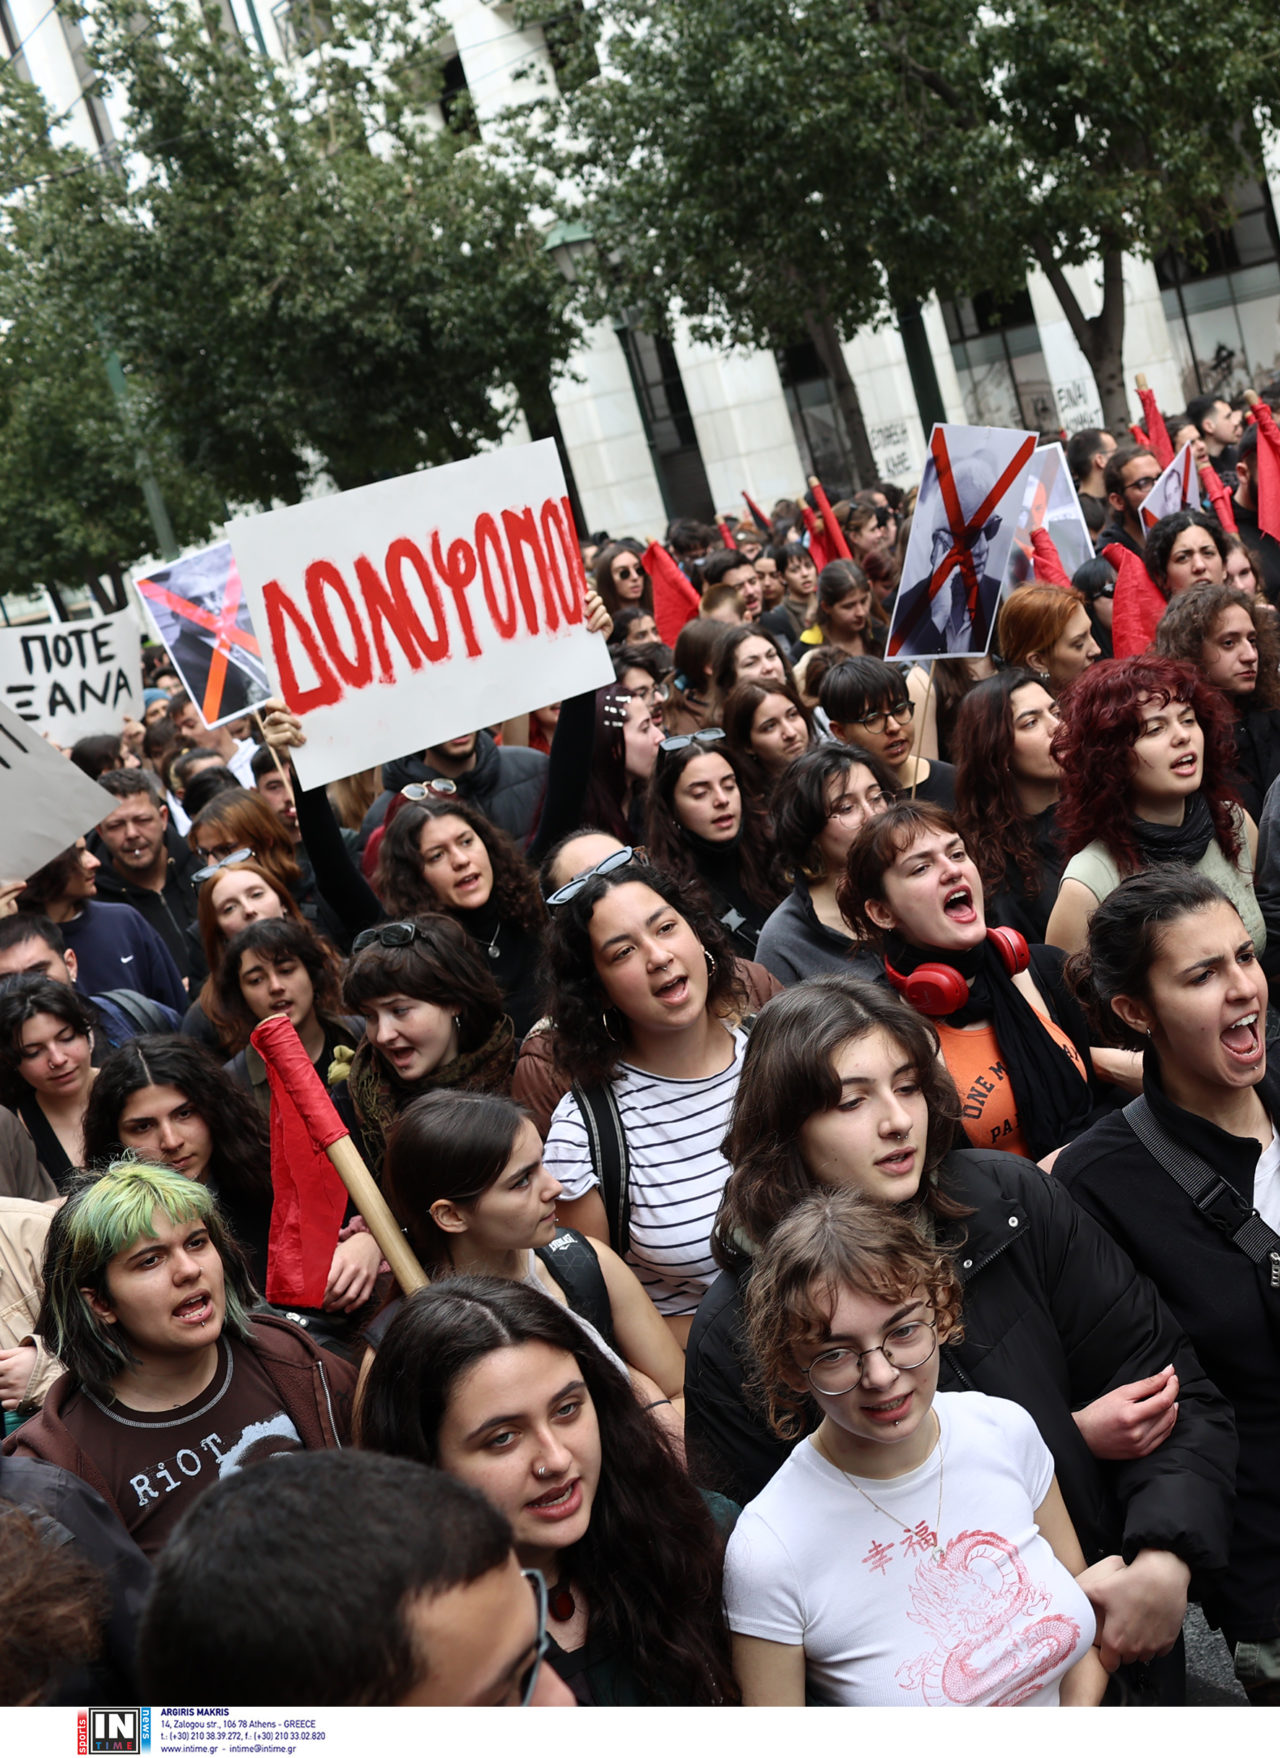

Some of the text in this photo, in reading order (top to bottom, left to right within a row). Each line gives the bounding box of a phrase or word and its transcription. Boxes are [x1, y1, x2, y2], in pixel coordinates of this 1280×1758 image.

[20, 622, 116, 675] ΠΟΤΕ
[6, 667, 133, 718] ΞΑΝΑ
[962, 1075, 996, 1120] ONE
[862, 1520, 938, 1576] 幸福
